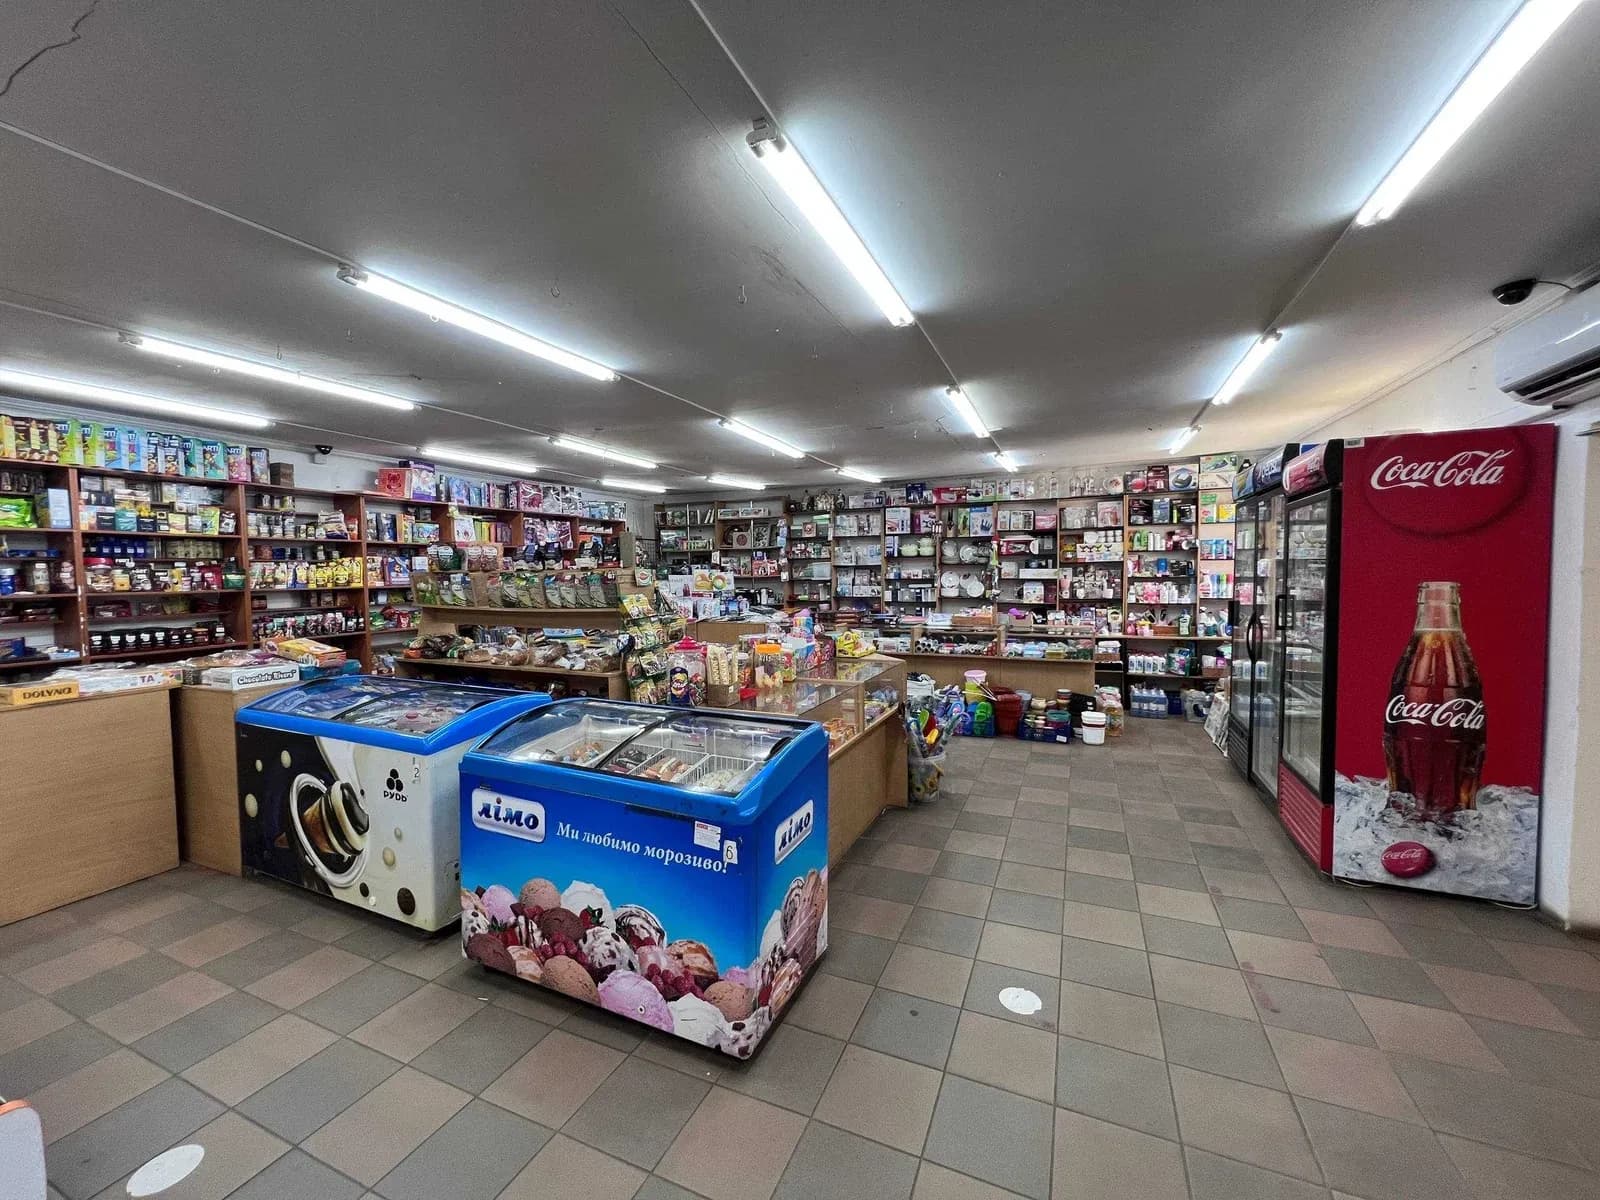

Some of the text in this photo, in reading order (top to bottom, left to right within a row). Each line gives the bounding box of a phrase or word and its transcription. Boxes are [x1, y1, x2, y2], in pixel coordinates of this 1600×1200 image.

[1370, 449, 1514, 490] Coca-Cola
[1386, 694, 1485, 729] Coca-Cola
[556, 822, 579, 840] Ми
[582, 832, 641, 854] любимо
[726, 845, 734, 860] 6
